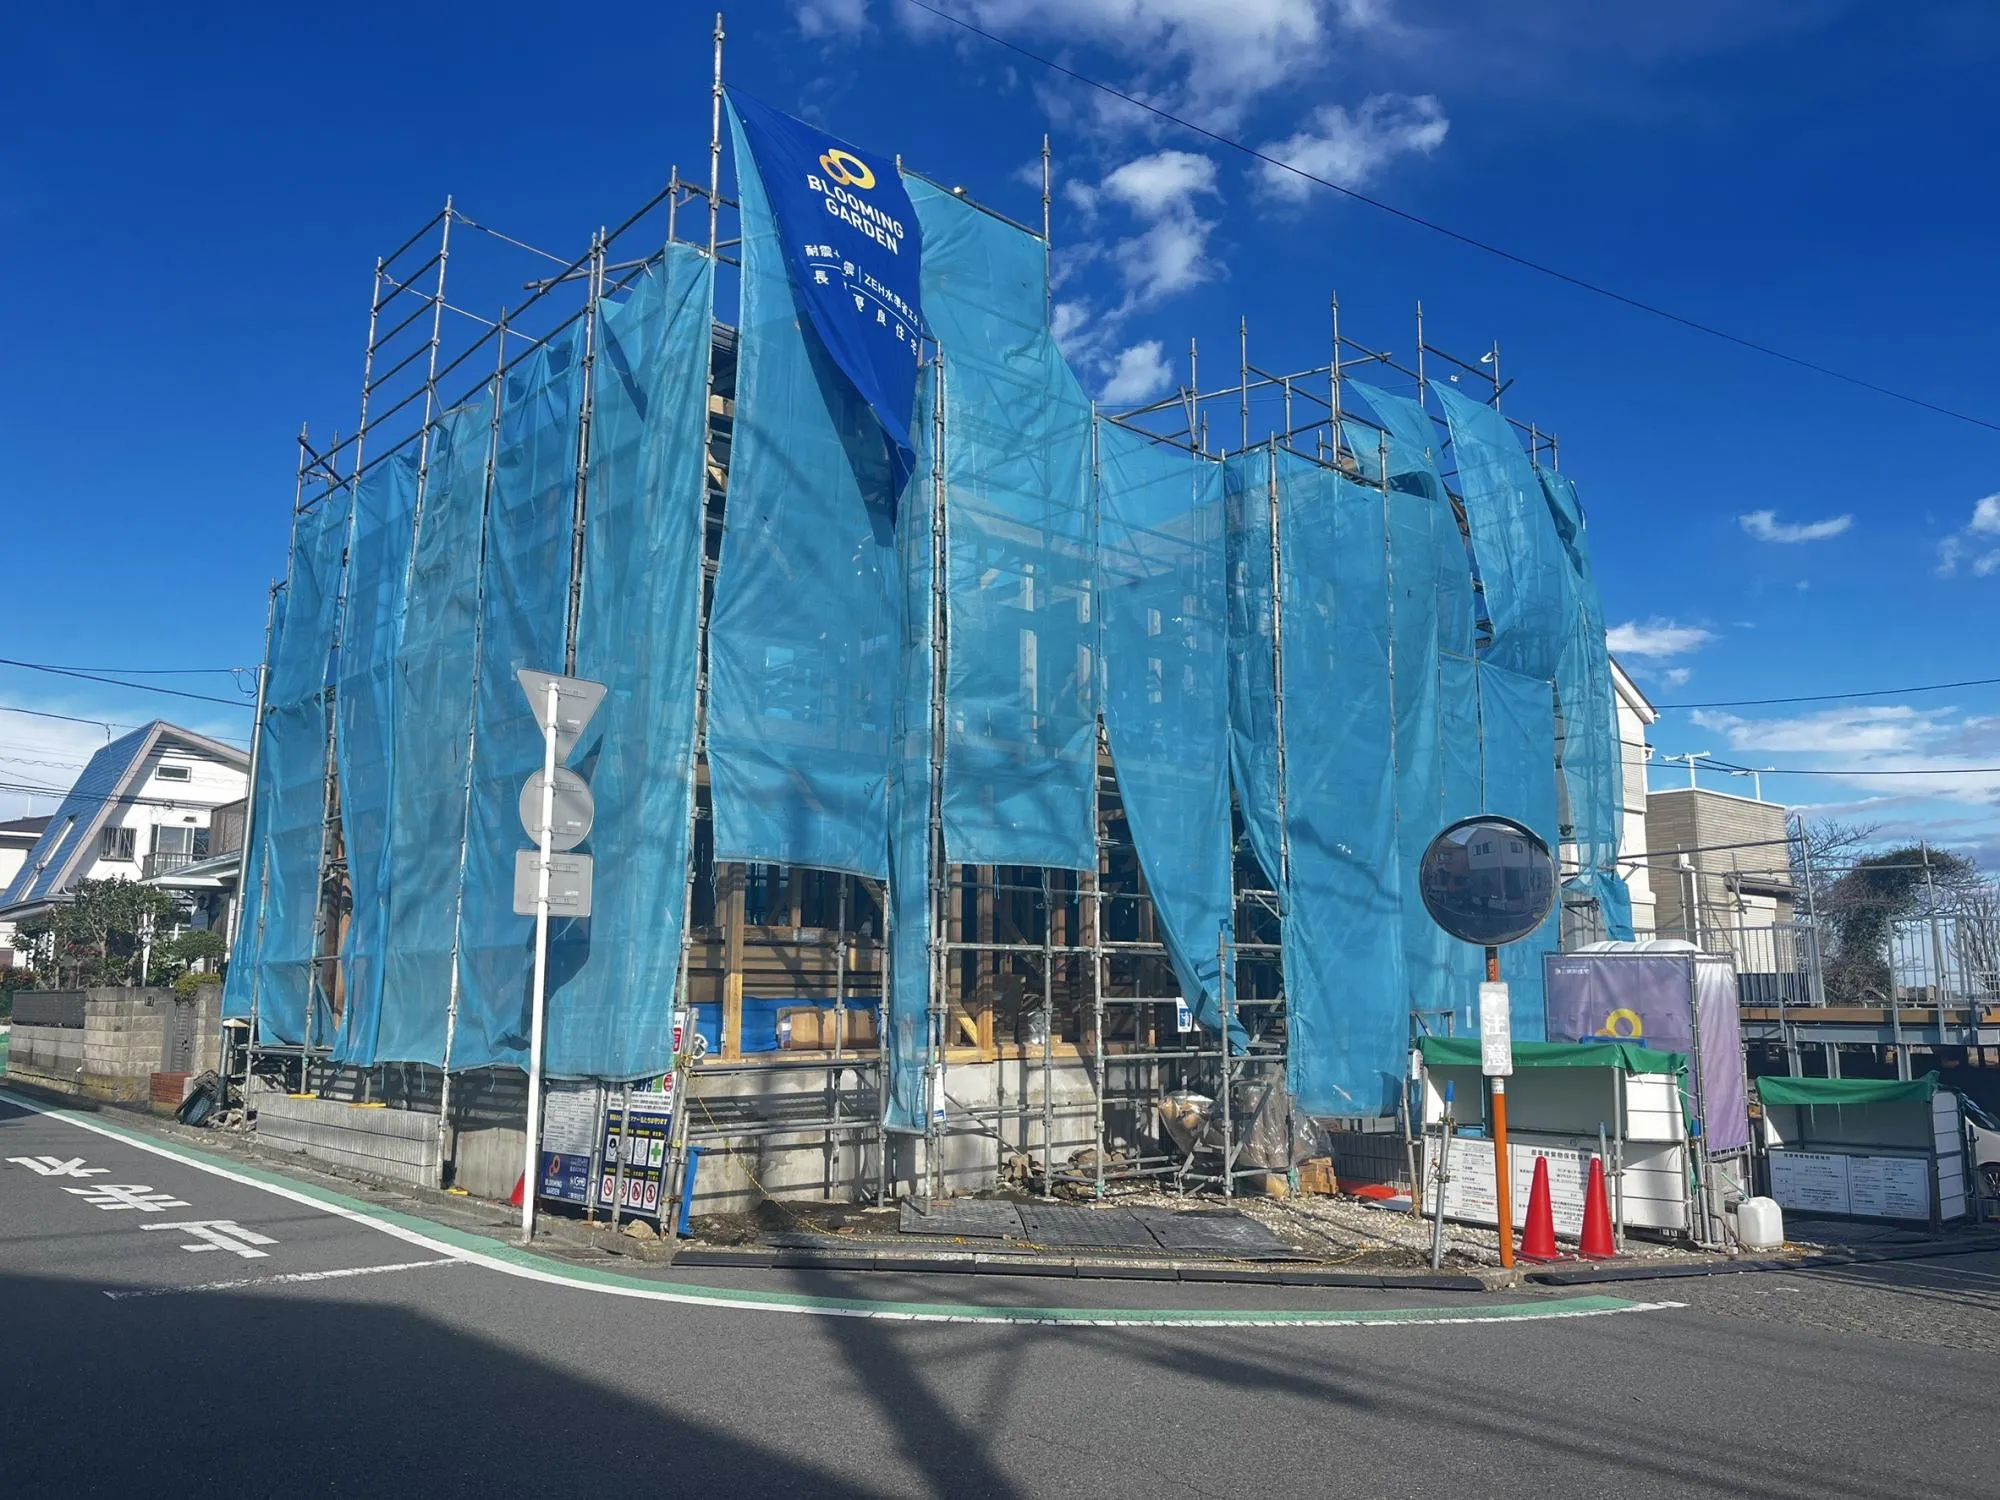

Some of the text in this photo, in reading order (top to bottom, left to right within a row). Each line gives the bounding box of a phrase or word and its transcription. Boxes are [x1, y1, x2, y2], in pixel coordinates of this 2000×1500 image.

[806, 174, 904, 239] BLOOMING
[825, 198, 898, 255] GARDEN
[1483, 1015, 1508, 1067] 注意
